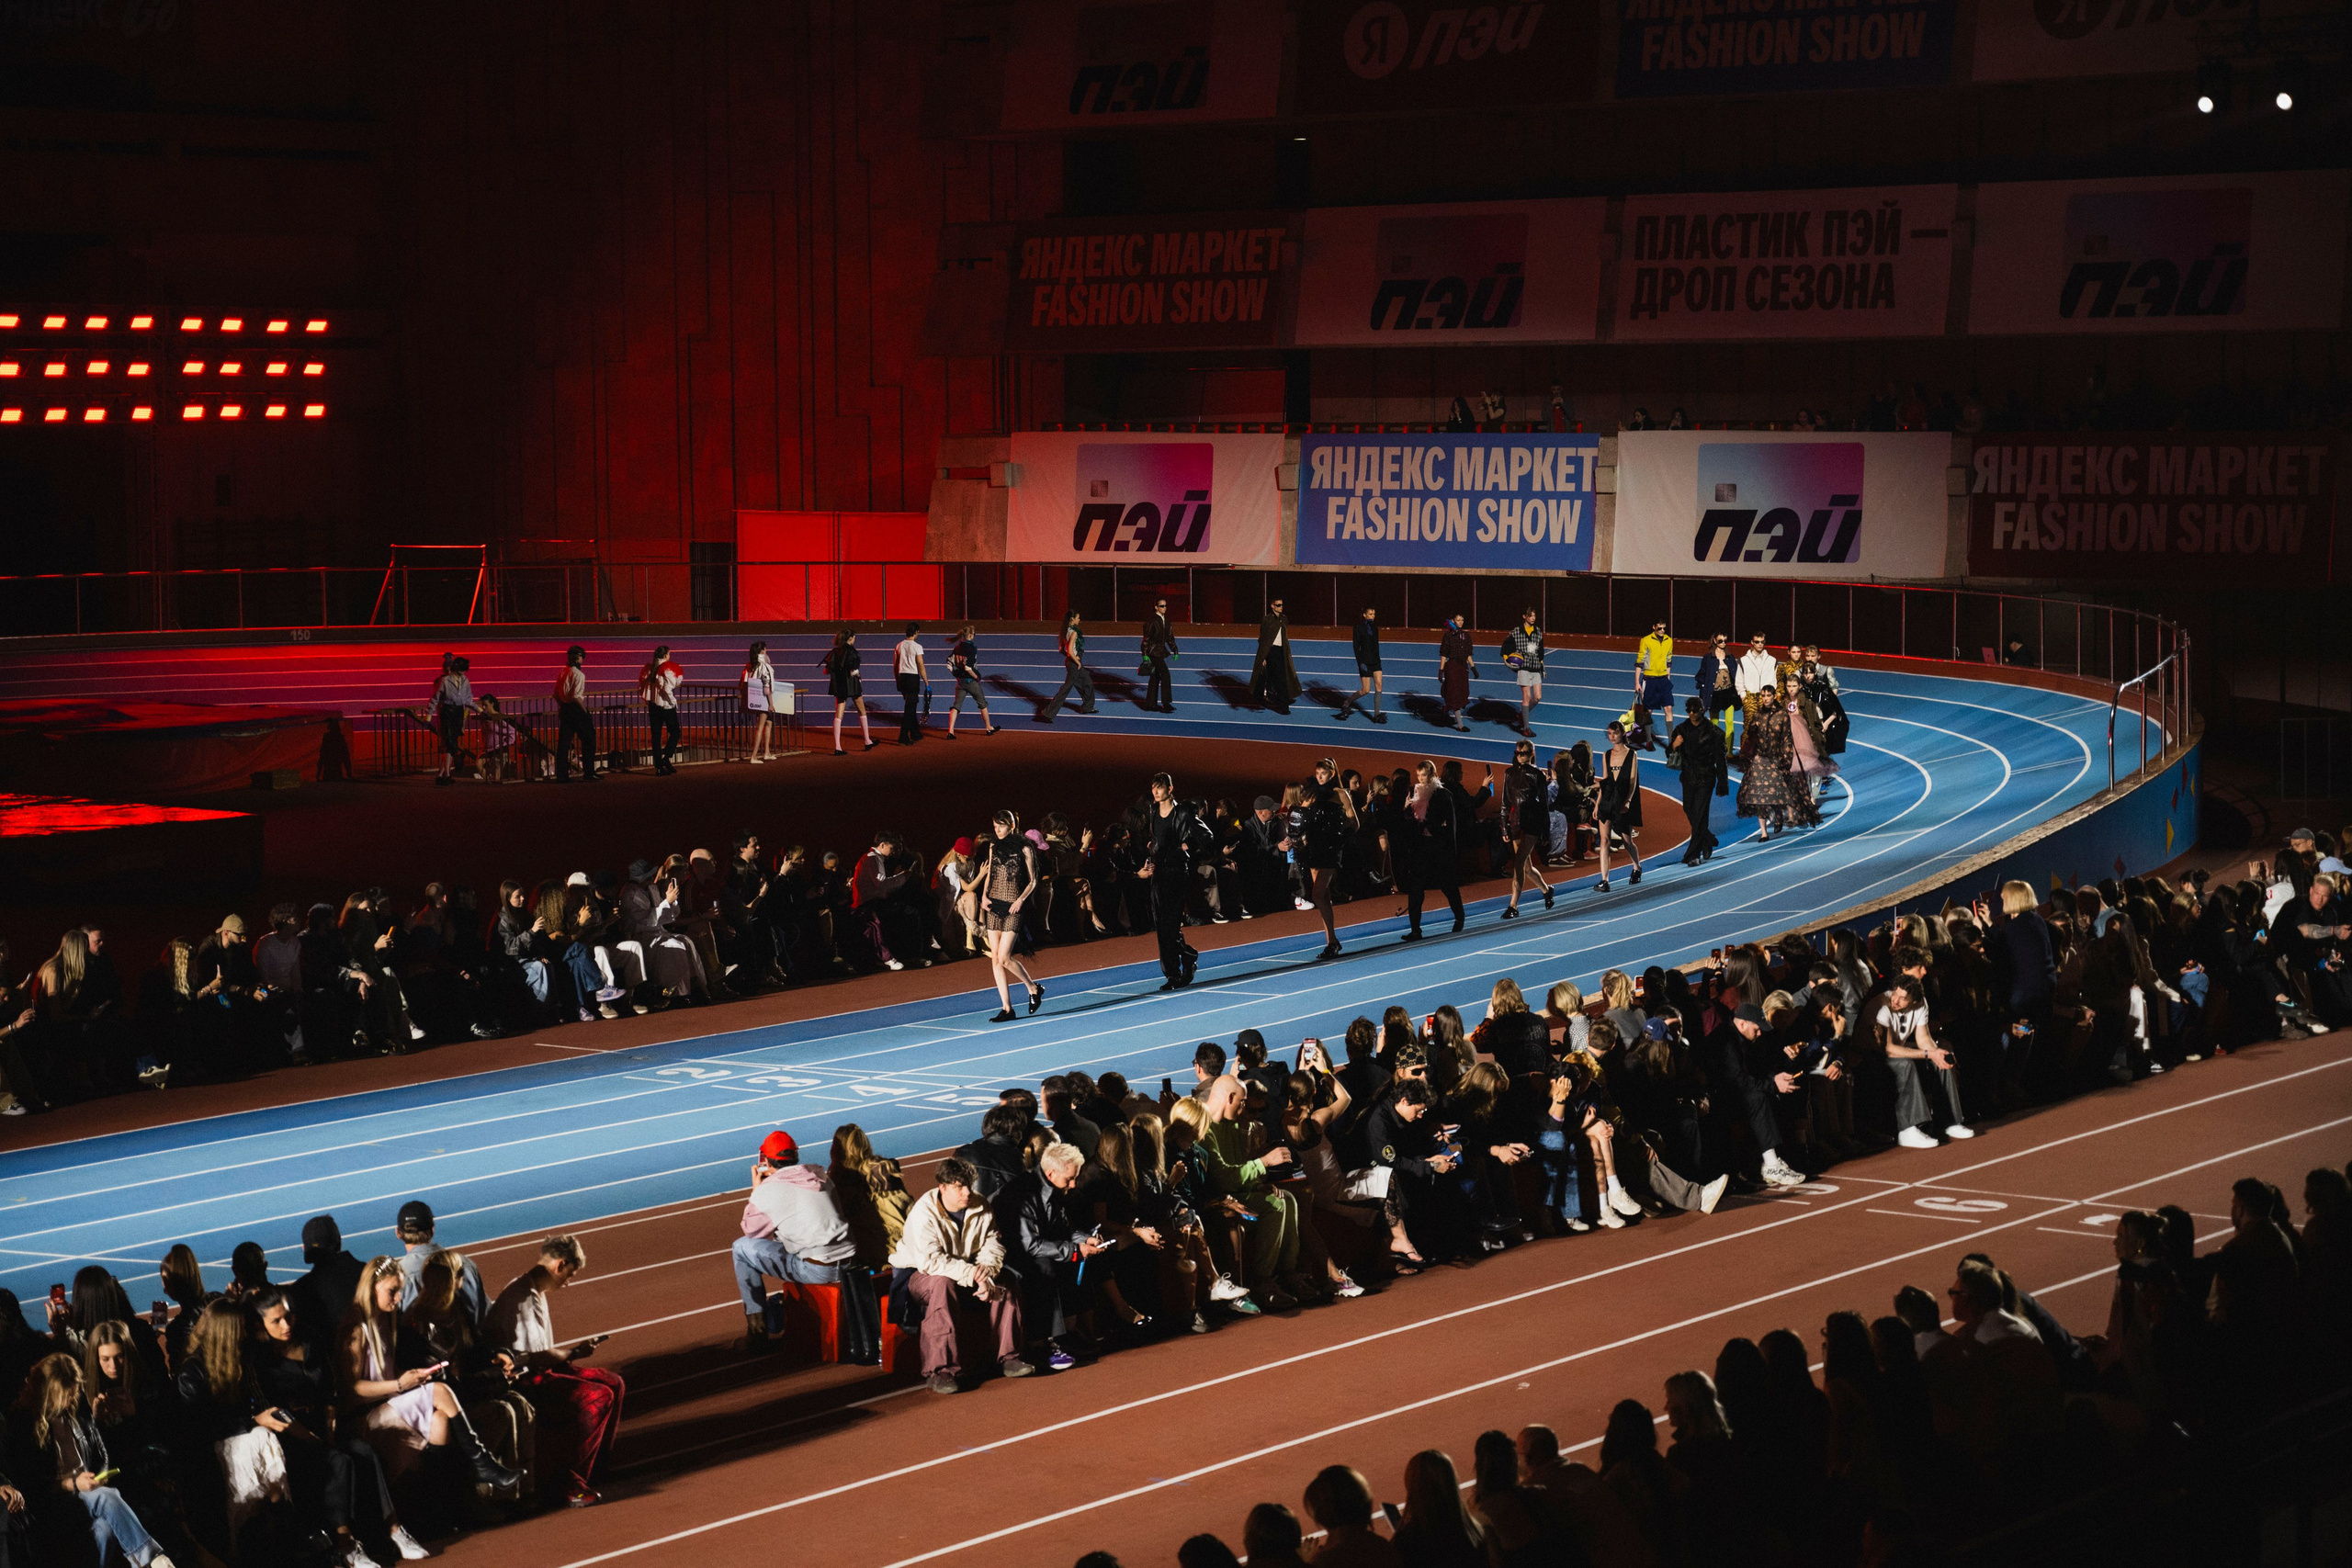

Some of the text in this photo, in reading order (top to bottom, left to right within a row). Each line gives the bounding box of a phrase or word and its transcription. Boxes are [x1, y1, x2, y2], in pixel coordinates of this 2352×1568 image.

[1640, 17, 1802, 72] FASHION
[1807, 10, 1928, 64] SHOW
[1634, 210, 1812, 261] ПЛАСТИК
[1822, 199, 1903, 257] ПЭЙ
[1019, 227, 1286, 285] ЯНДЕКС МАРКЕТ
[1030, 277, 1269, 327] FASHION SHOW
[1629, 262, 1896, 320] ДРОП СЕЗОНА
[1309, 446, 1600, 497] ЯНДЕКС МАРКЕТ
[1972, 445, 2329, 502] ЯНДЕКС МАРКЕТ
[1326, 495, 1583, 545] FASHION SHOW
[1991, 501, 2308, 554] FASHION SHOW
[290, 629, 311, 641] 150
[654, 1066, 732, 1080] 2
[746, 1075, 822, 1089] 3
[848, 1084, 920, 1097] 4
[922, 1093, 1001, 1107] 5
[1914, 1196, 2008, 1213] 6
